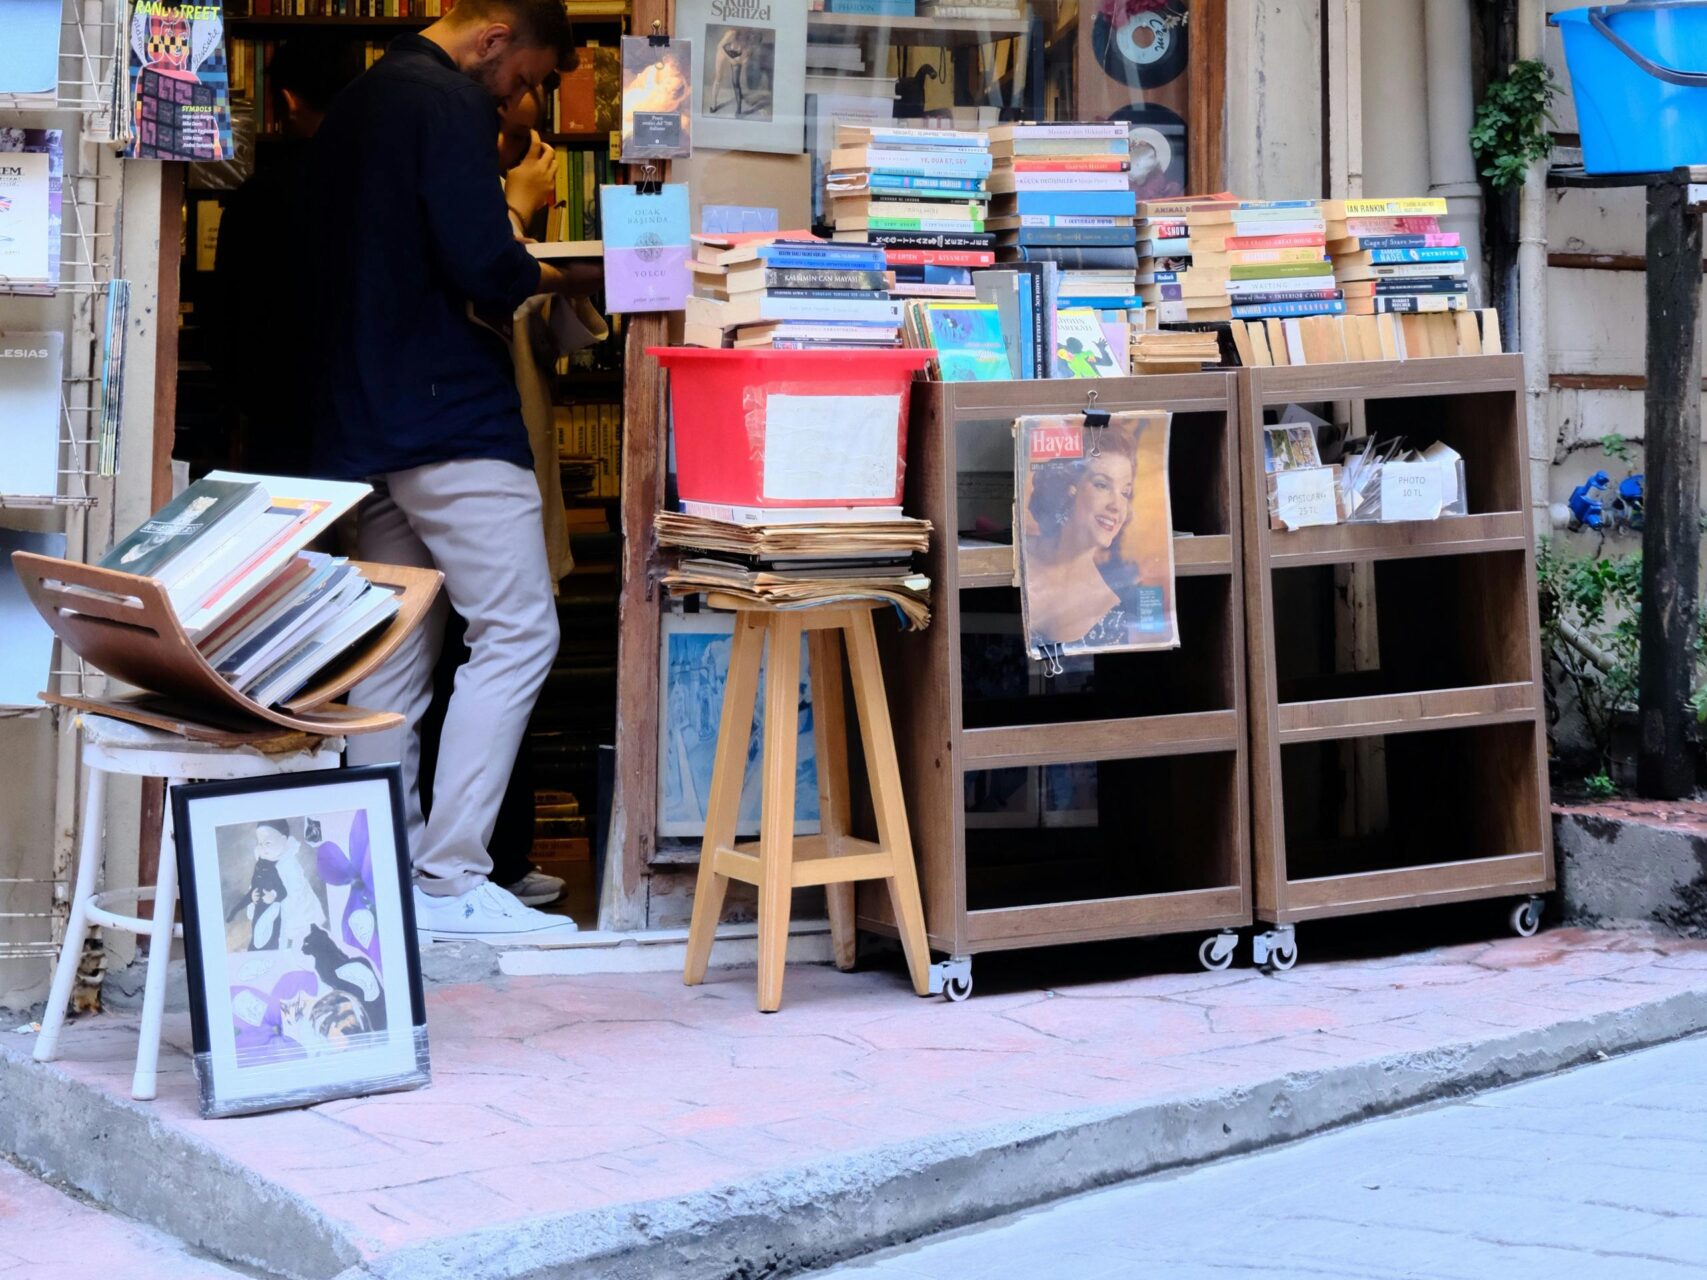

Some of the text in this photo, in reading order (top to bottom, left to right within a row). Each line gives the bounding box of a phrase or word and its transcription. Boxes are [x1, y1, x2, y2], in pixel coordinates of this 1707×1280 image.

[181, 105, 212, 113] SYMBOLS
[1154, 206, 1185, 214] ANIMAL
[1346, 204, 1385, 213] IAN RANKIN
[1032, 430, 1081, 456] Hayat
[1398, 476, 1426, 485] PHOTO
[1402, 488, 1423, 497] 10 TL
